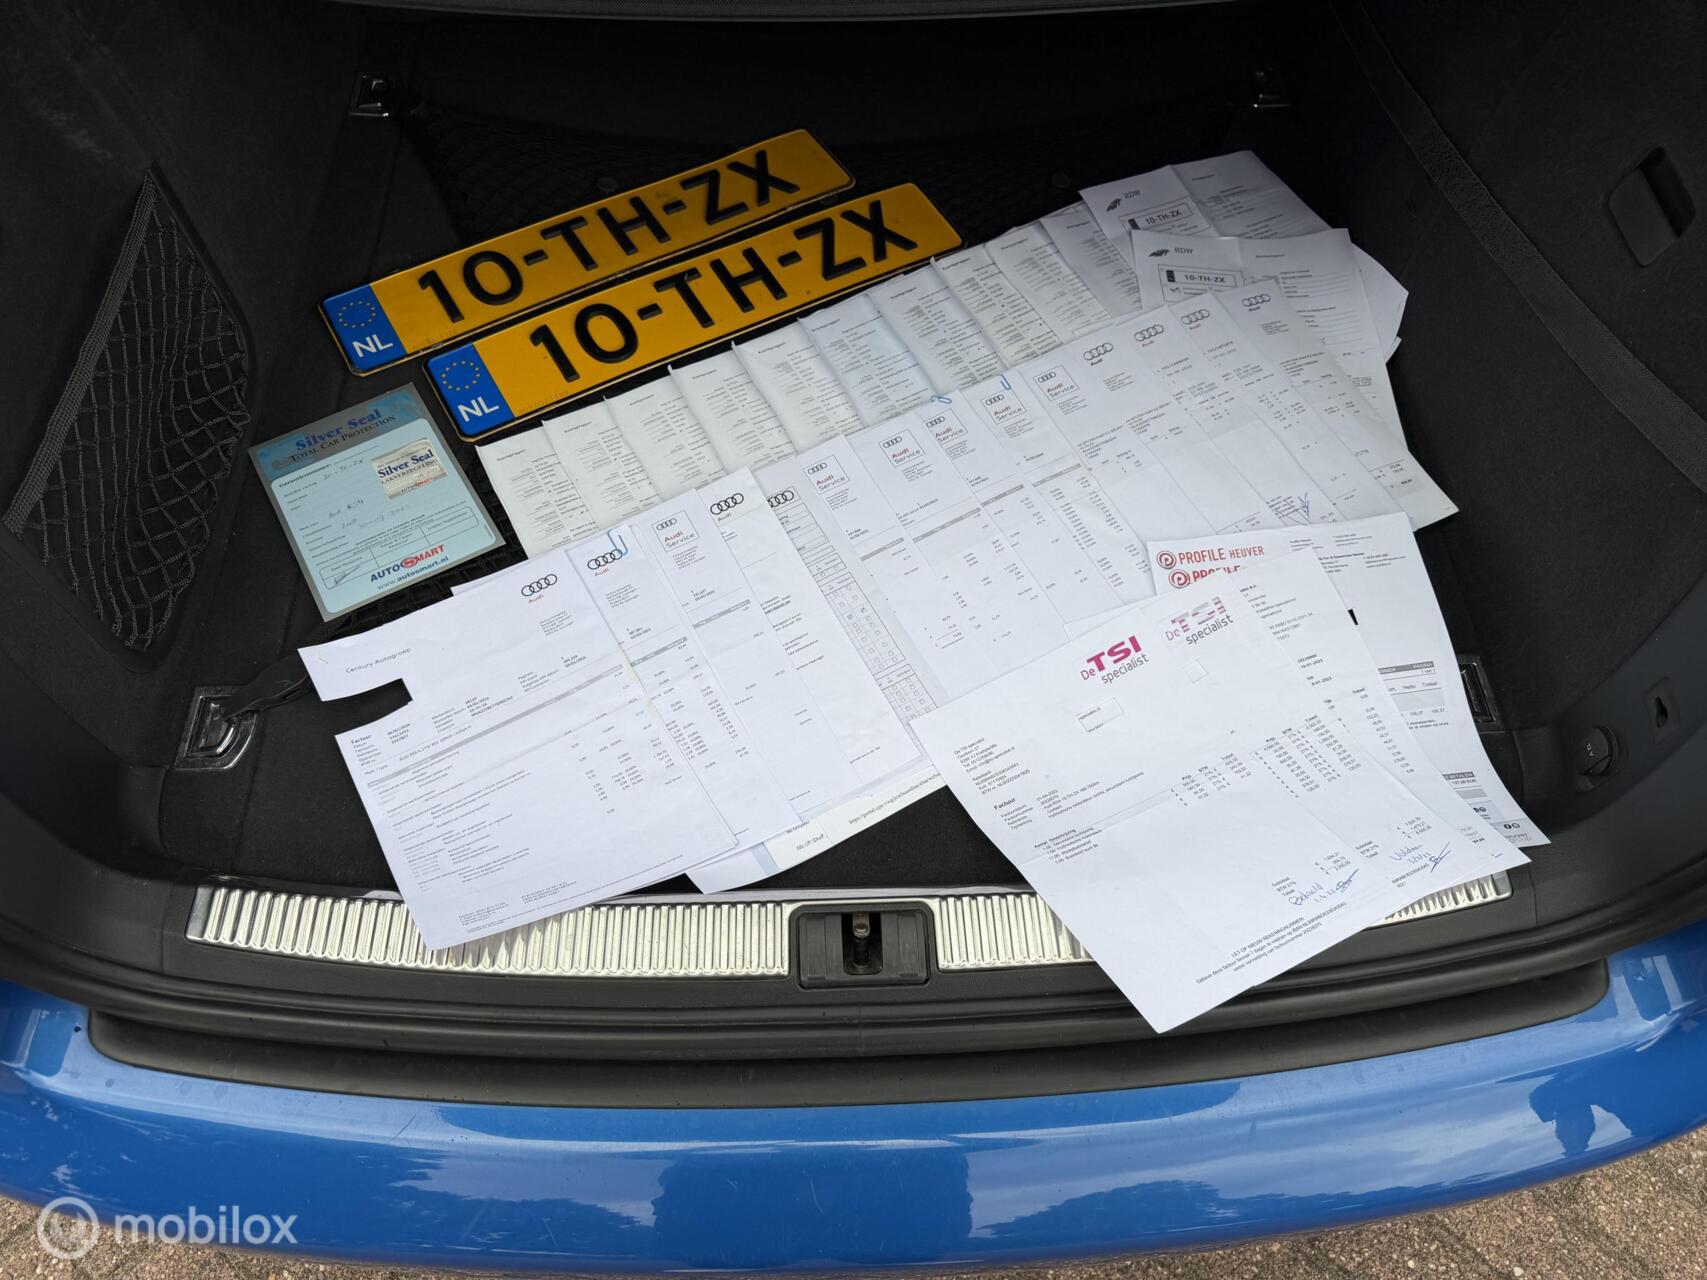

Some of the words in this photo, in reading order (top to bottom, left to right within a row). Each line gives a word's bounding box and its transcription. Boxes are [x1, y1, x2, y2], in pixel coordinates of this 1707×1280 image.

[1145, 209, 1181, 225] 10-TH-ZX
[418, 149, 800, 324] 10-TH-ZX
[1184, 274, 1225, 283] 10-TH-ZX
[531, 199, 917, 384] 10-TH-ZX
[352, 333, 393, 359] NL
[1047, 383, 1064, 393] Audi
[1049, 384, 1075, 398] Service
[457, 396, 499, 423] NL
[993, 405, 1011, 416] Audi
[995, 407, 1022, 421] Service
[295, 424, 341, 451] Silver
[347, 408, 382, 429] Seal
[935, 427, 952, 438] Audi
[937, 428, 964, 443] Service
[891, 448, 909, 458] Audi
[894, 449, 921, 465] Service
[377, 461, 409, 478] Silver
[411, 449, 434, 465] Seal
[816, 474, 834, 485] Audi
[818, 476, 845, 491] Service
[717, 512, 732, 522] Audi
[664, 531, 683, 542] Audi
[665, 533, 695, 549] Service
[1178, 547, 1226, 565] PROFILE
[1229, 546, 1265, 559] HEUVER
[377, 556, 449, 590] www.autosmart.nl
[594, 567, 610, 577] Audi
[528, 594, 544, 604] Audi
[1170, 596, 1227, 634] TSI
[1186, 614, 1234, 645] specialist
[345, 662, 374, 674] Century
[374, 647, 412, 667] Autogroep
[1086, 635, 1143, 672] TSI
[1080, 667, 1097, 682] De
[1101, 653, 1149, 684] specialist
[993, 797, 1016, 810] Factuur
